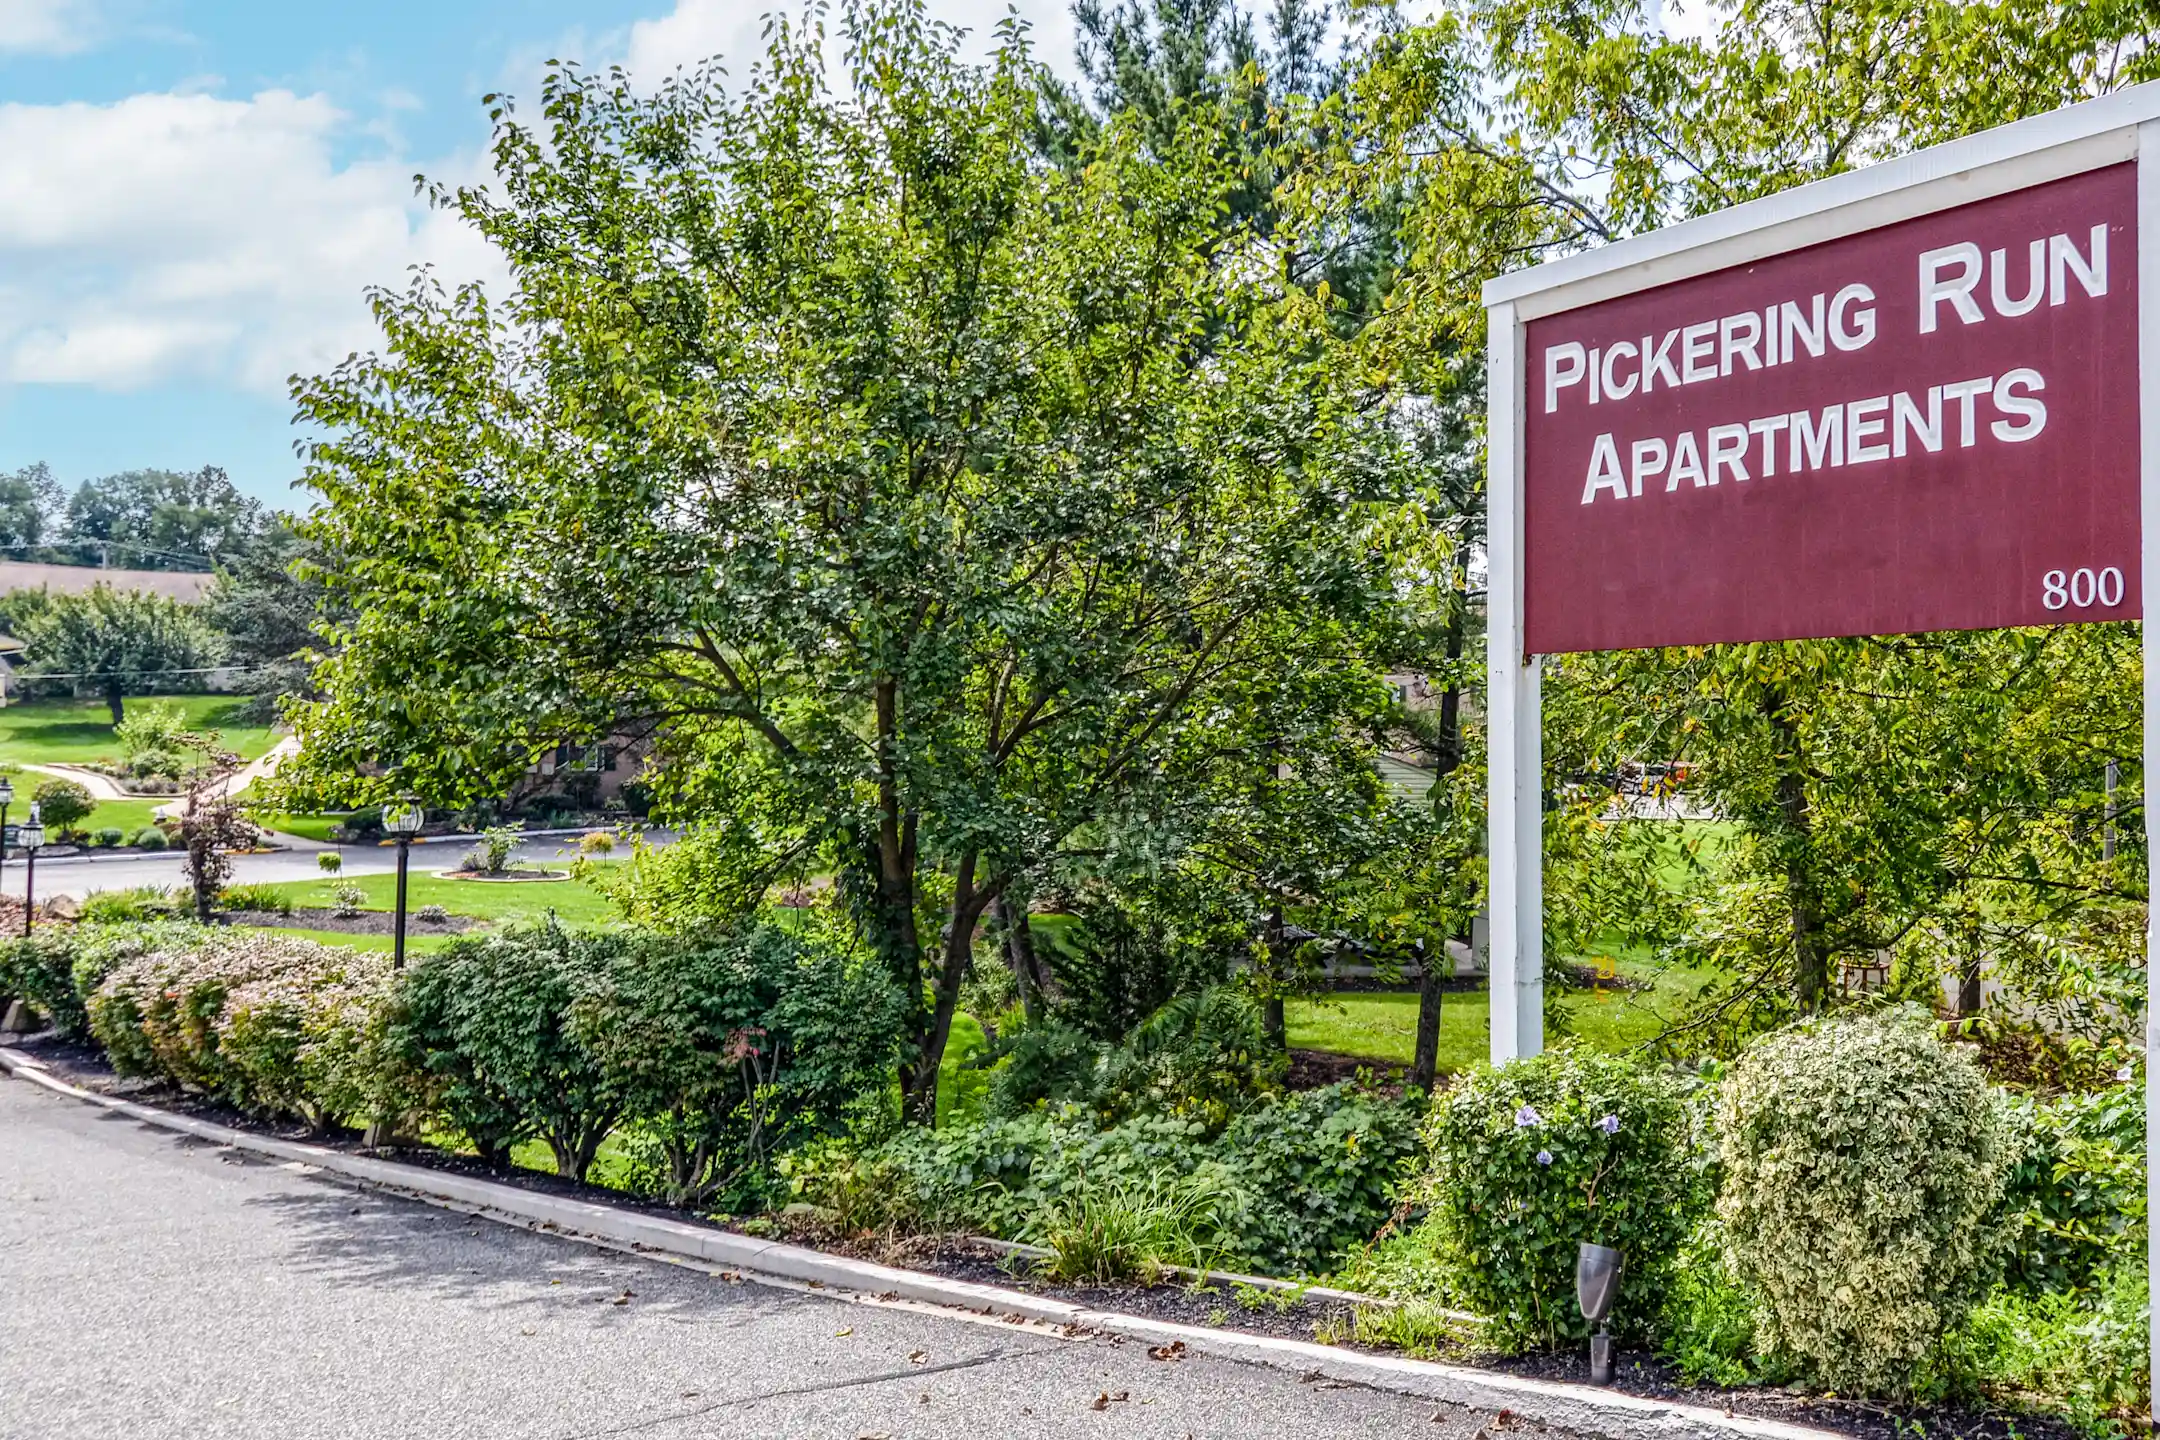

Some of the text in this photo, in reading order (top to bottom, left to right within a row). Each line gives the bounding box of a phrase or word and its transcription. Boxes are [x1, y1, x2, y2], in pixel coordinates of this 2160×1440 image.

[1544, 222, 2109, 414] PICKERING RUN
[1580, 367, 2048, 505] APARTMENTS
[2042, 566, 2125, 610] 800
